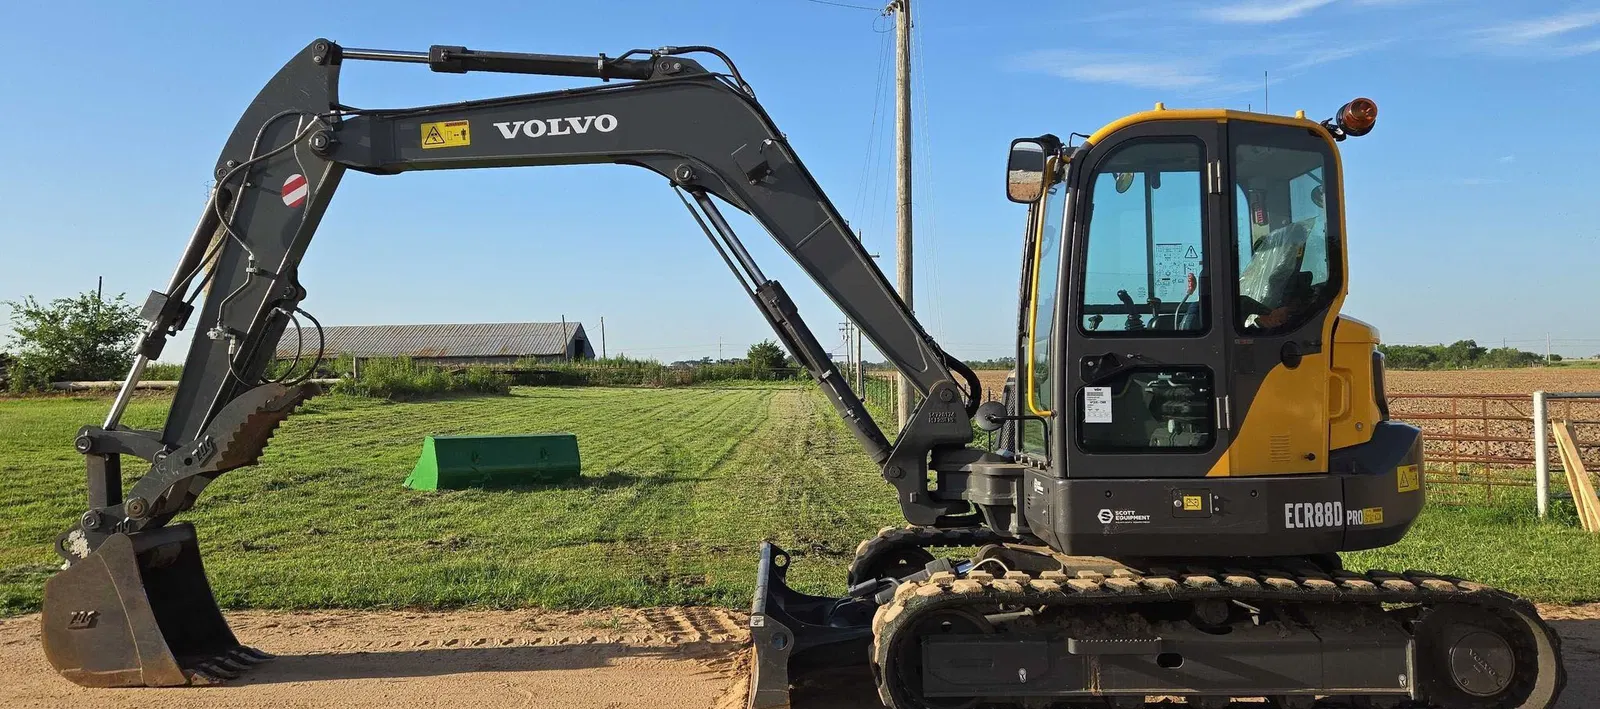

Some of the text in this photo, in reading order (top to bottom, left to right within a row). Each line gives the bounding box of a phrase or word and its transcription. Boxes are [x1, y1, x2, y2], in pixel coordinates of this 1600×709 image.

[493, 114, 618, 139] VOLVO
[1284, 501, 1364, 529] ECR88D PRO
